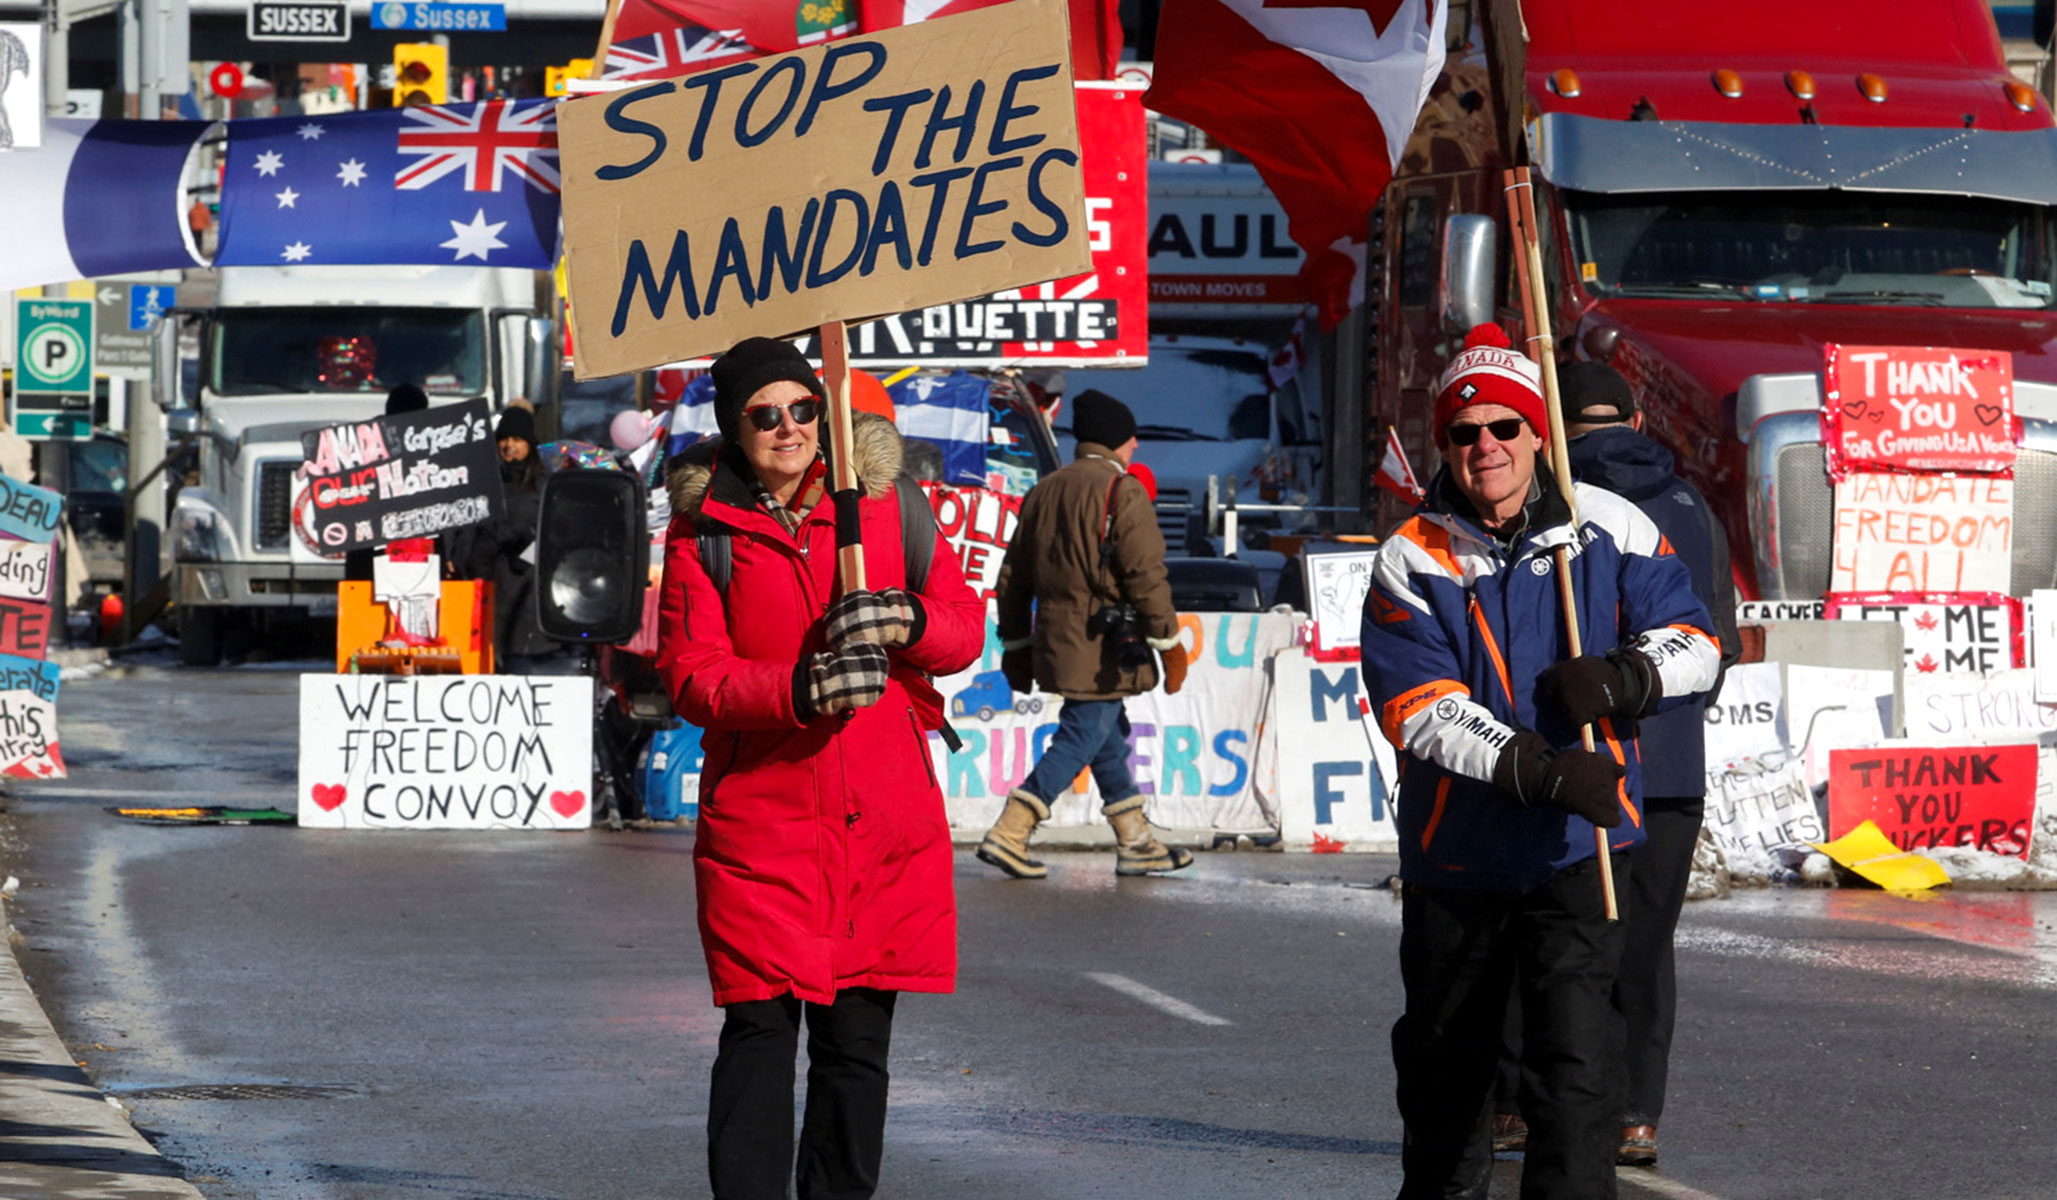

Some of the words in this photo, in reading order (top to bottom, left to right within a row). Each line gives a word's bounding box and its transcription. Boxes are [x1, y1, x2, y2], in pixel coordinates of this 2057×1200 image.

[261, 7, 337, 33] SUSSEX
[415, 3, 491, 29] Sussex
[595, 41, 887, 180] STOP
[862, 63, 1062, 176] THE
[611, 148, 1079, 338] MANDATES
[1206, 283, 1266, 296] MOVES
[1837, 508, 2011, 552] FREEDOM
[1944, 605, 1999, 643] ME
[0, 699, 44, 738] his
[336, 679, 554, 727] WELCOME
[338, 728, 554, 776] FREEDOM
[1851, 753, 2003, 788] THANK
[364, 782, 547, 826] CONVOY
[1896, 791, 1962, 824] YOU
[1758, 814, 1821, 851] LIES
